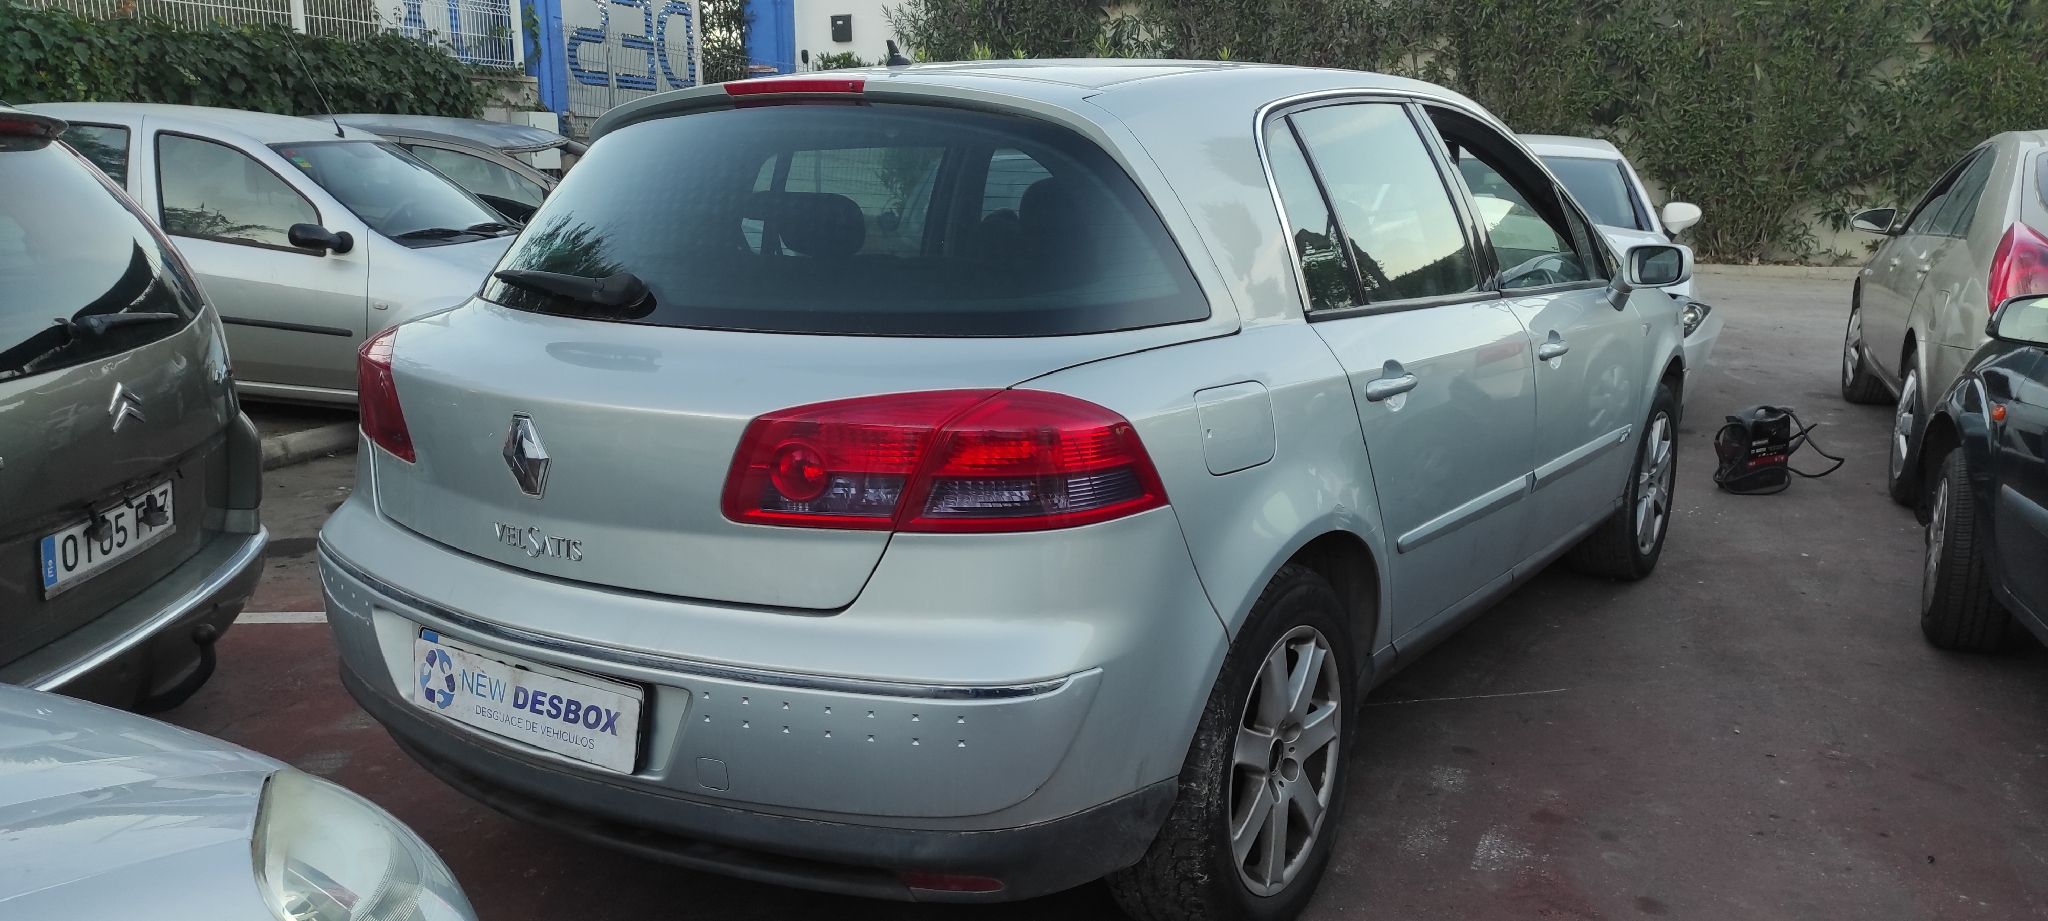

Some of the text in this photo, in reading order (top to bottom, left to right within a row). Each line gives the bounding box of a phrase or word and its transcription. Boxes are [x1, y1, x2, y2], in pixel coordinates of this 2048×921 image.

[461, 668, 621, 736] NEW DESBOX
[524, 718, 538, 734] DE
[541, 724, 595, 750] VEHICULOS
